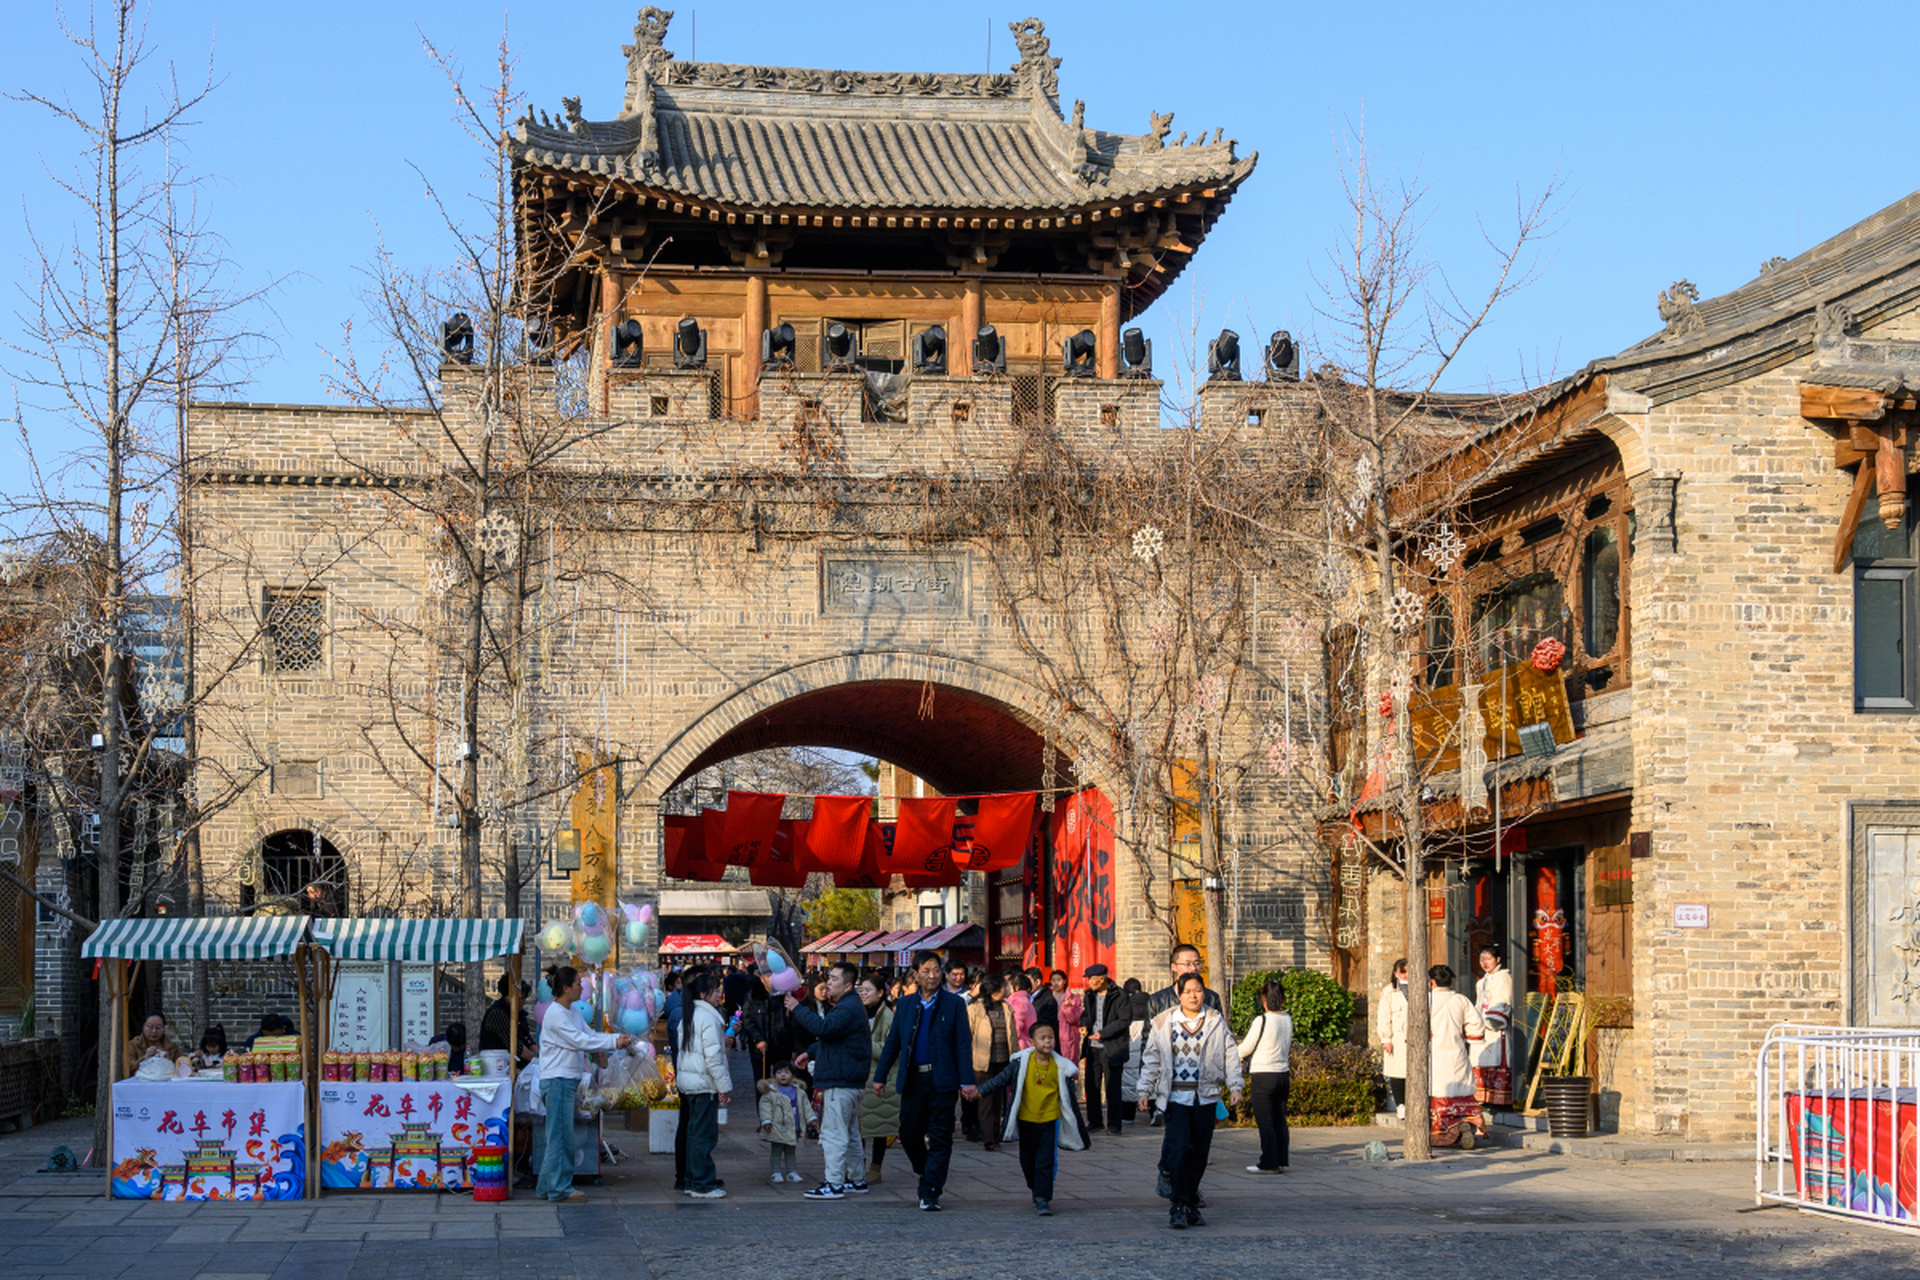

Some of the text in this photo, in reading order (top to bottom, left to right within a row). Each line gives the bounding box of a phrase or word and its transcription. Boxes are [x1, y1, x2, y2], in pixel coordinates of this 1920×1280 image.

[363, 1091, 475, 1122] 花车市集
[156, 1108, 269, 1139] 花车市集
